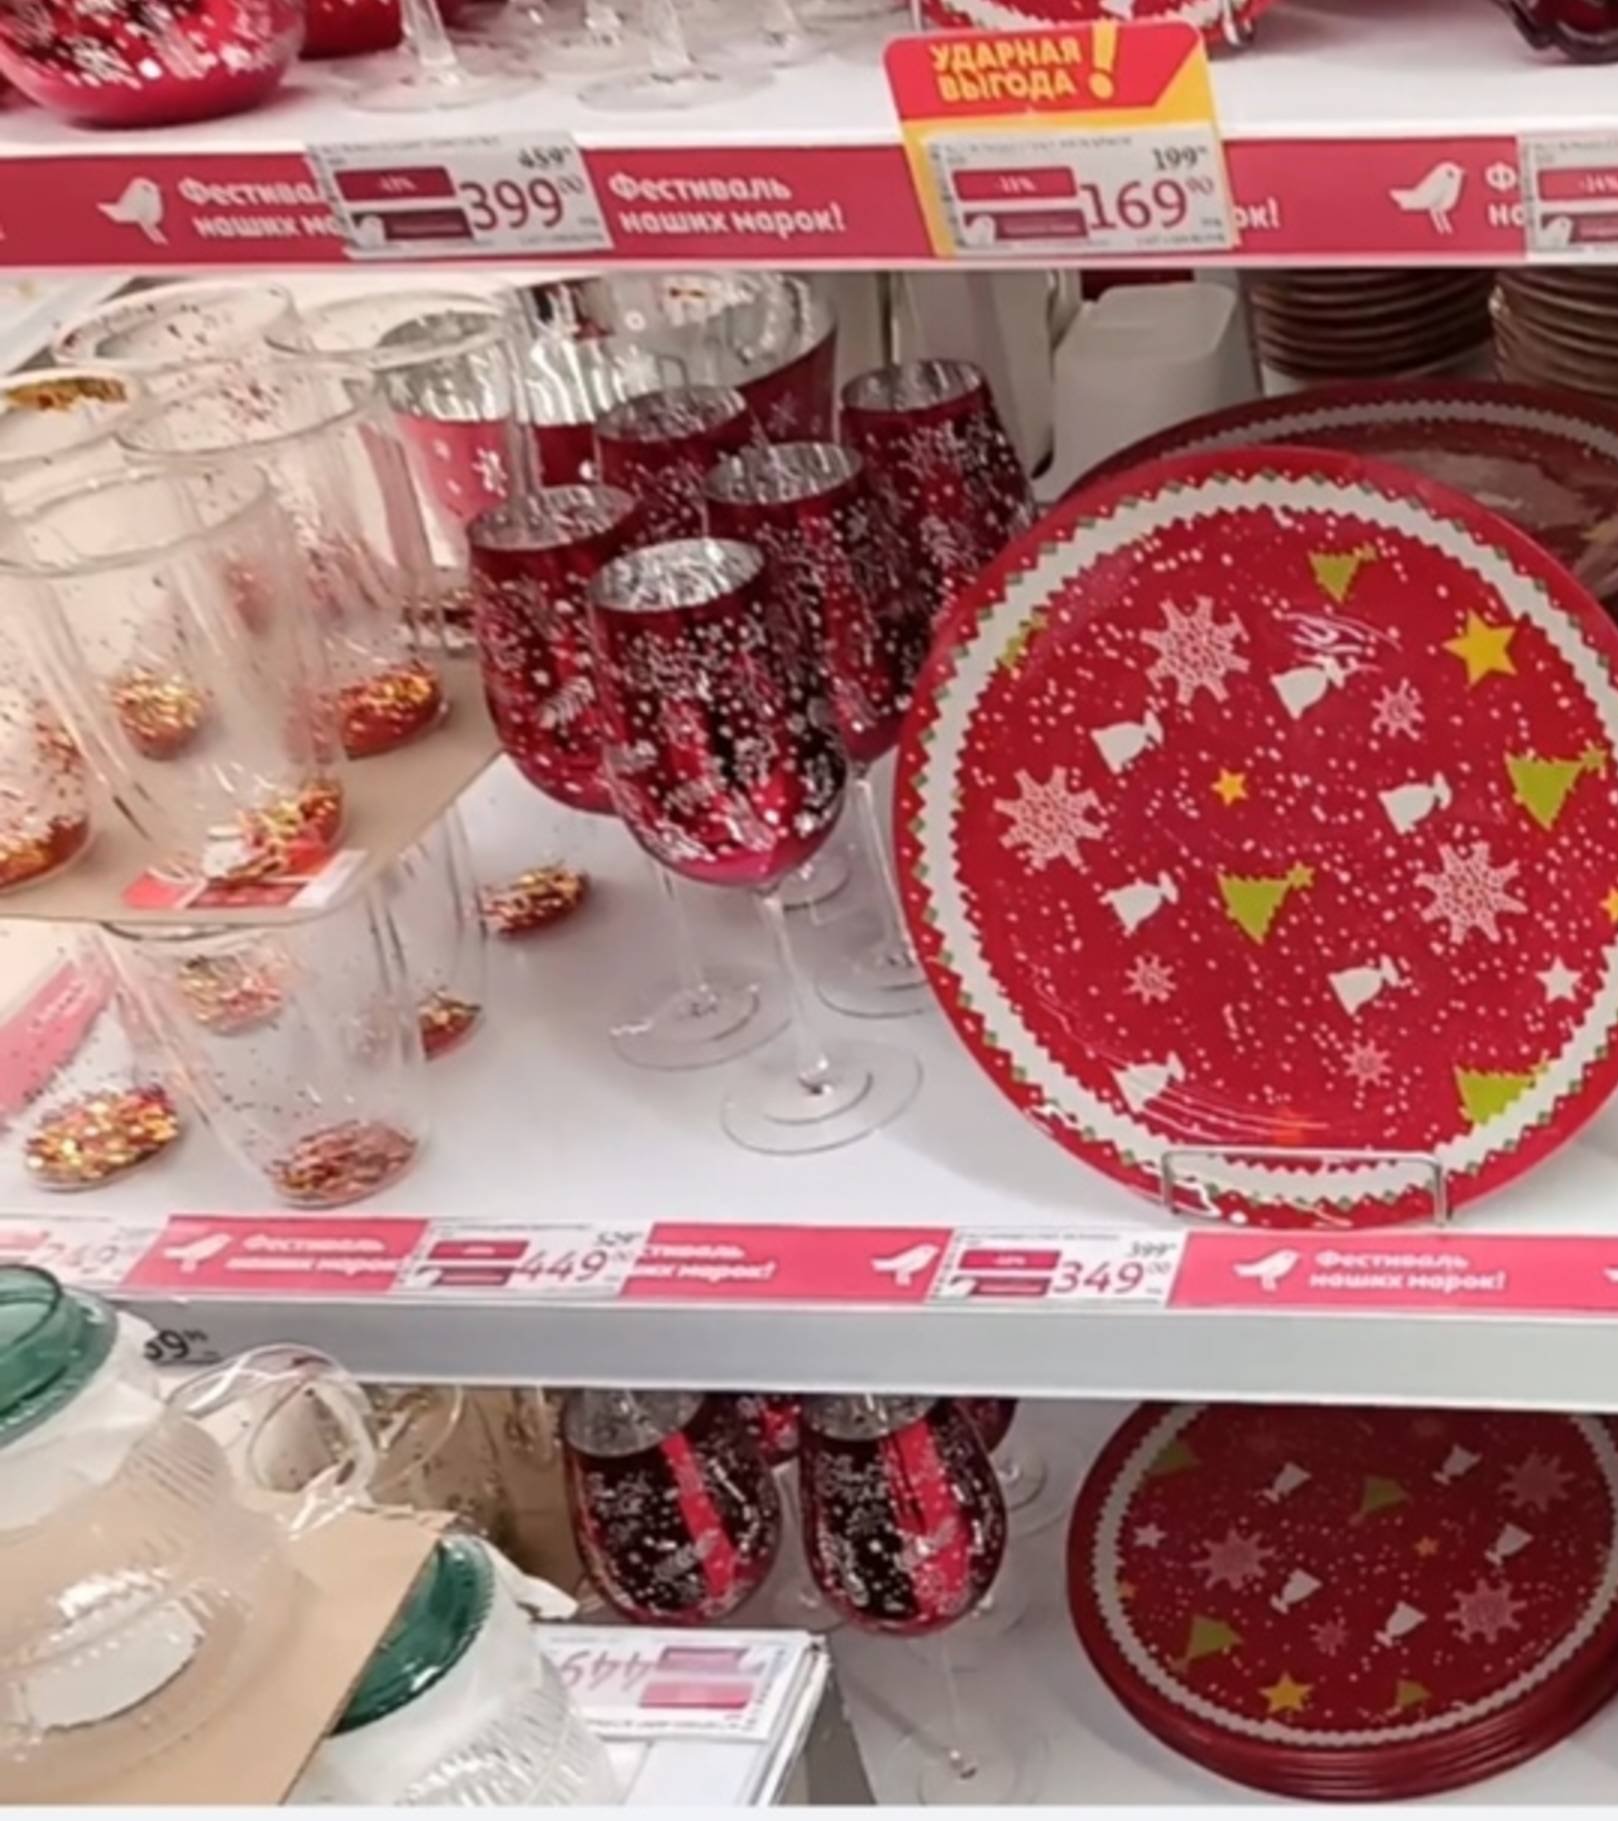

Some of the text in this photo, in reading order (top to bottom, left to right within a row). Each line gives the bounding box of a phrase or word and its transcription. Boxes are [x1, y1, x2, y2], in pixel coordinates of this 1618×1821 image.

[932, 36, 1081, 72] УДАРНАЯ
[938, 68, 1078, 101] ВЫГОДА
[1153, 146, 1199, 171] 199
[459, 176, 565, 231] 399
[608, 173, 793, 202] Фестиваль
[1080, 178, 1188, 230] 169
[192, 215, 299, 240] наших
[620, 202, 847, 240] наших марок!
[522, 1249, 609, 1282] 449
[1314, 1250, 1469, 1269] Фестиваль
[1053, 1260, 1145, 1295] 349
[1309, 1270, 1506, 1293] наших марок!
